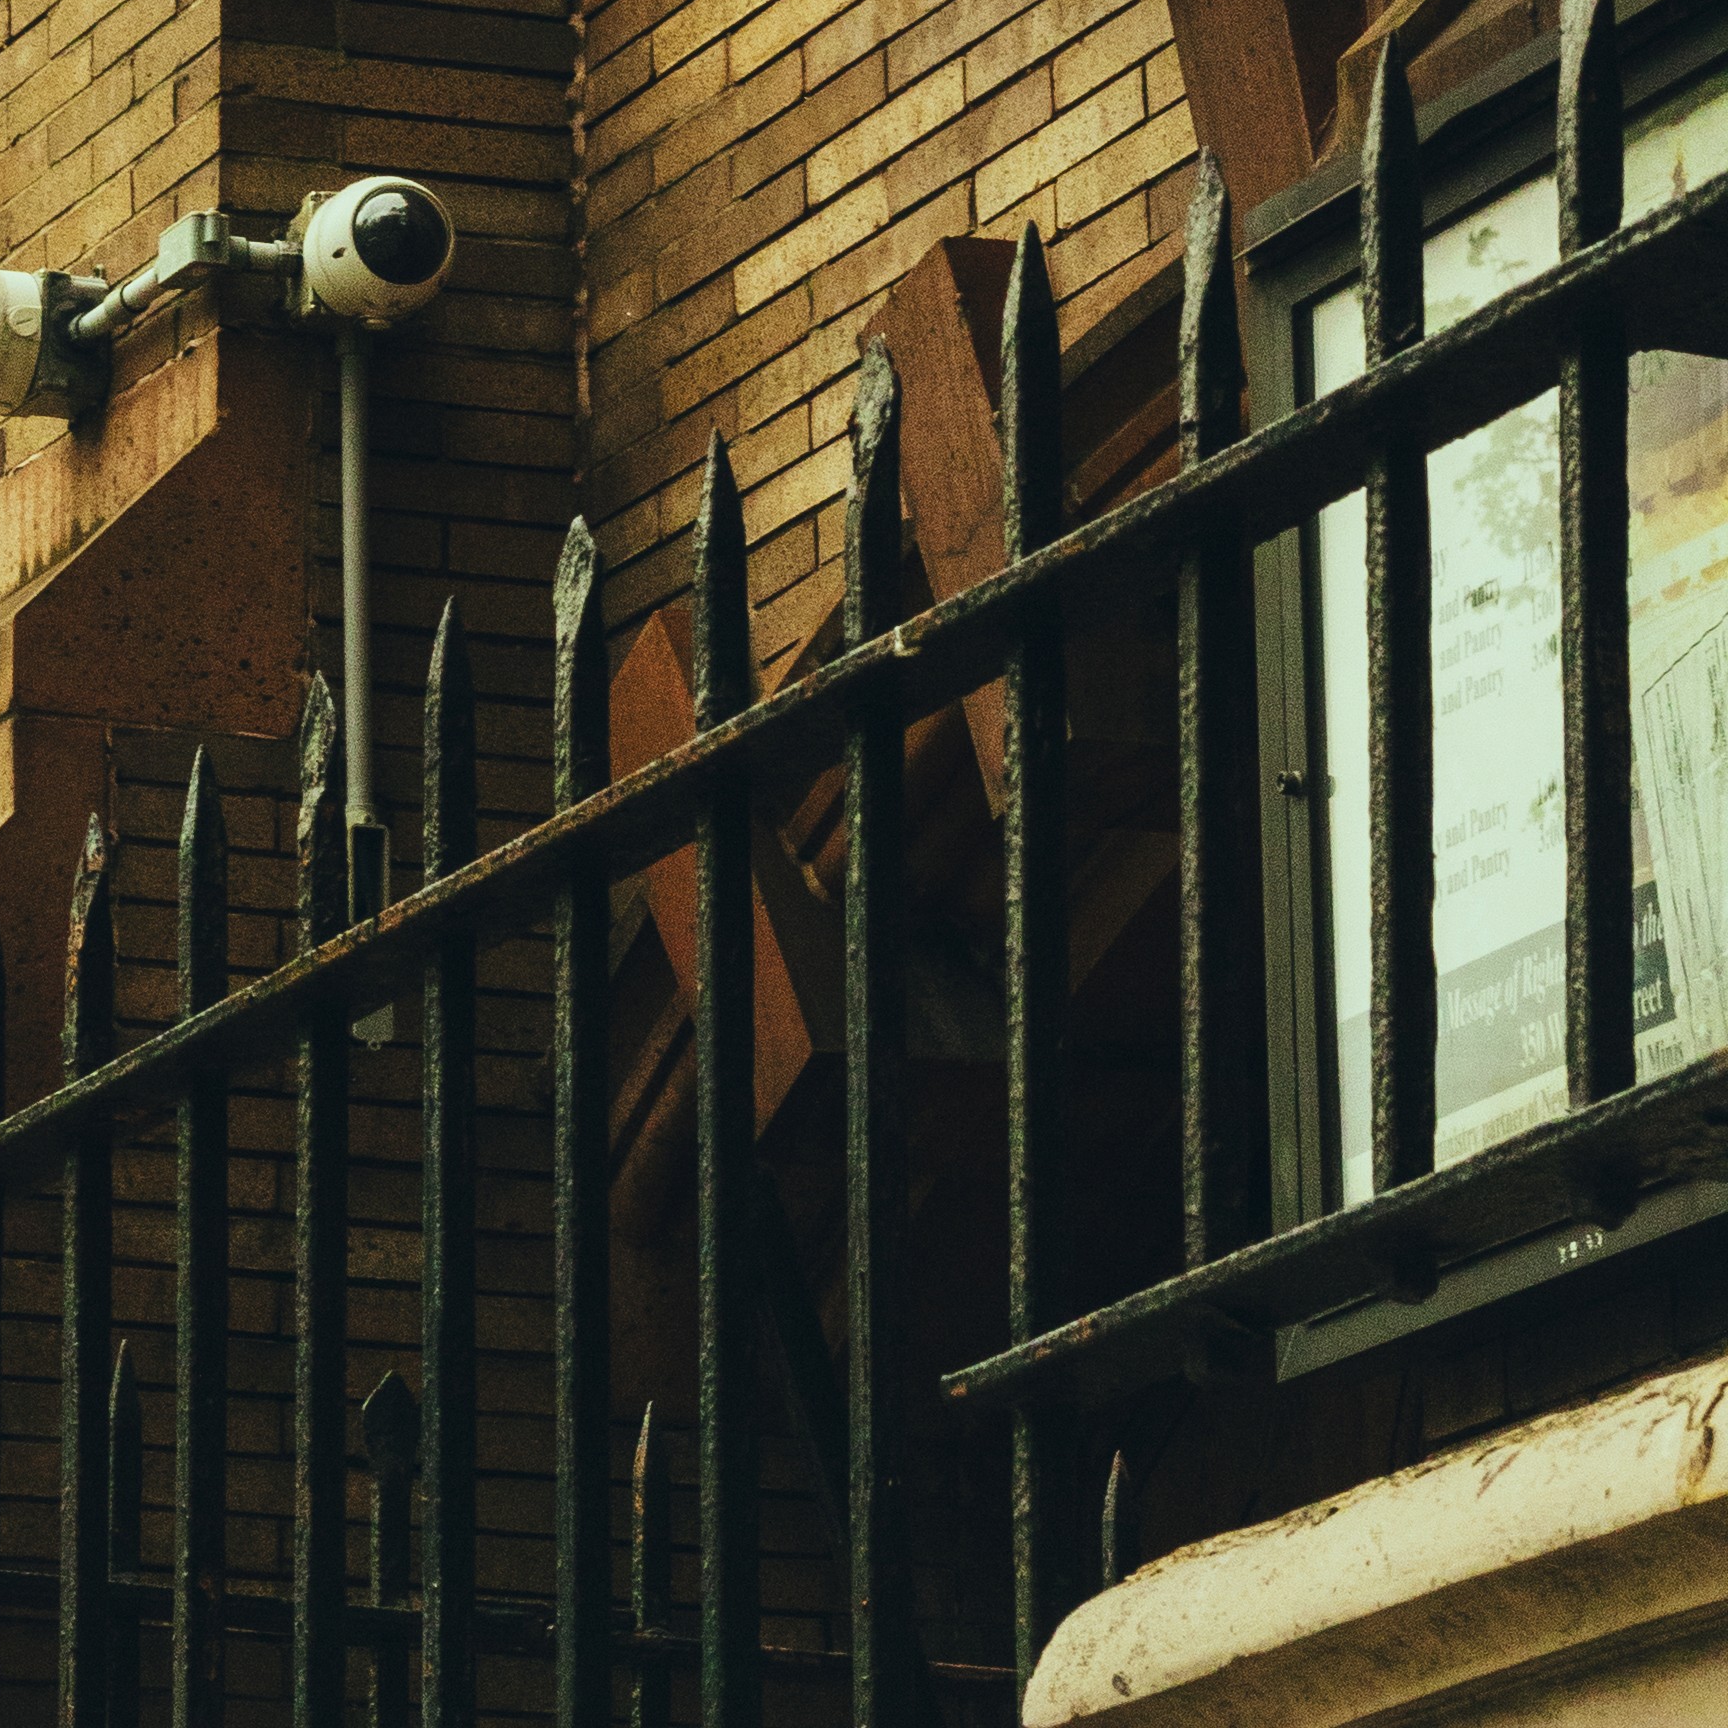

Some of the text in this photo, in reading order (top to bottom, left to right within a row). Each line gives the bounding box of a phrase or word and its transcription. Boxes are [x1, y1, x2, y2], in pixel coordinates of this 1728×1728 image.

[1464, 623, 1502, 658] Pantry
[1465, 668, 1504, 705] Pantry
[1470, 800, 1509, 837] Pantry
[1471, 846, 1511, 884] Pantry
[1447, 981, 1502, 1029] Message
